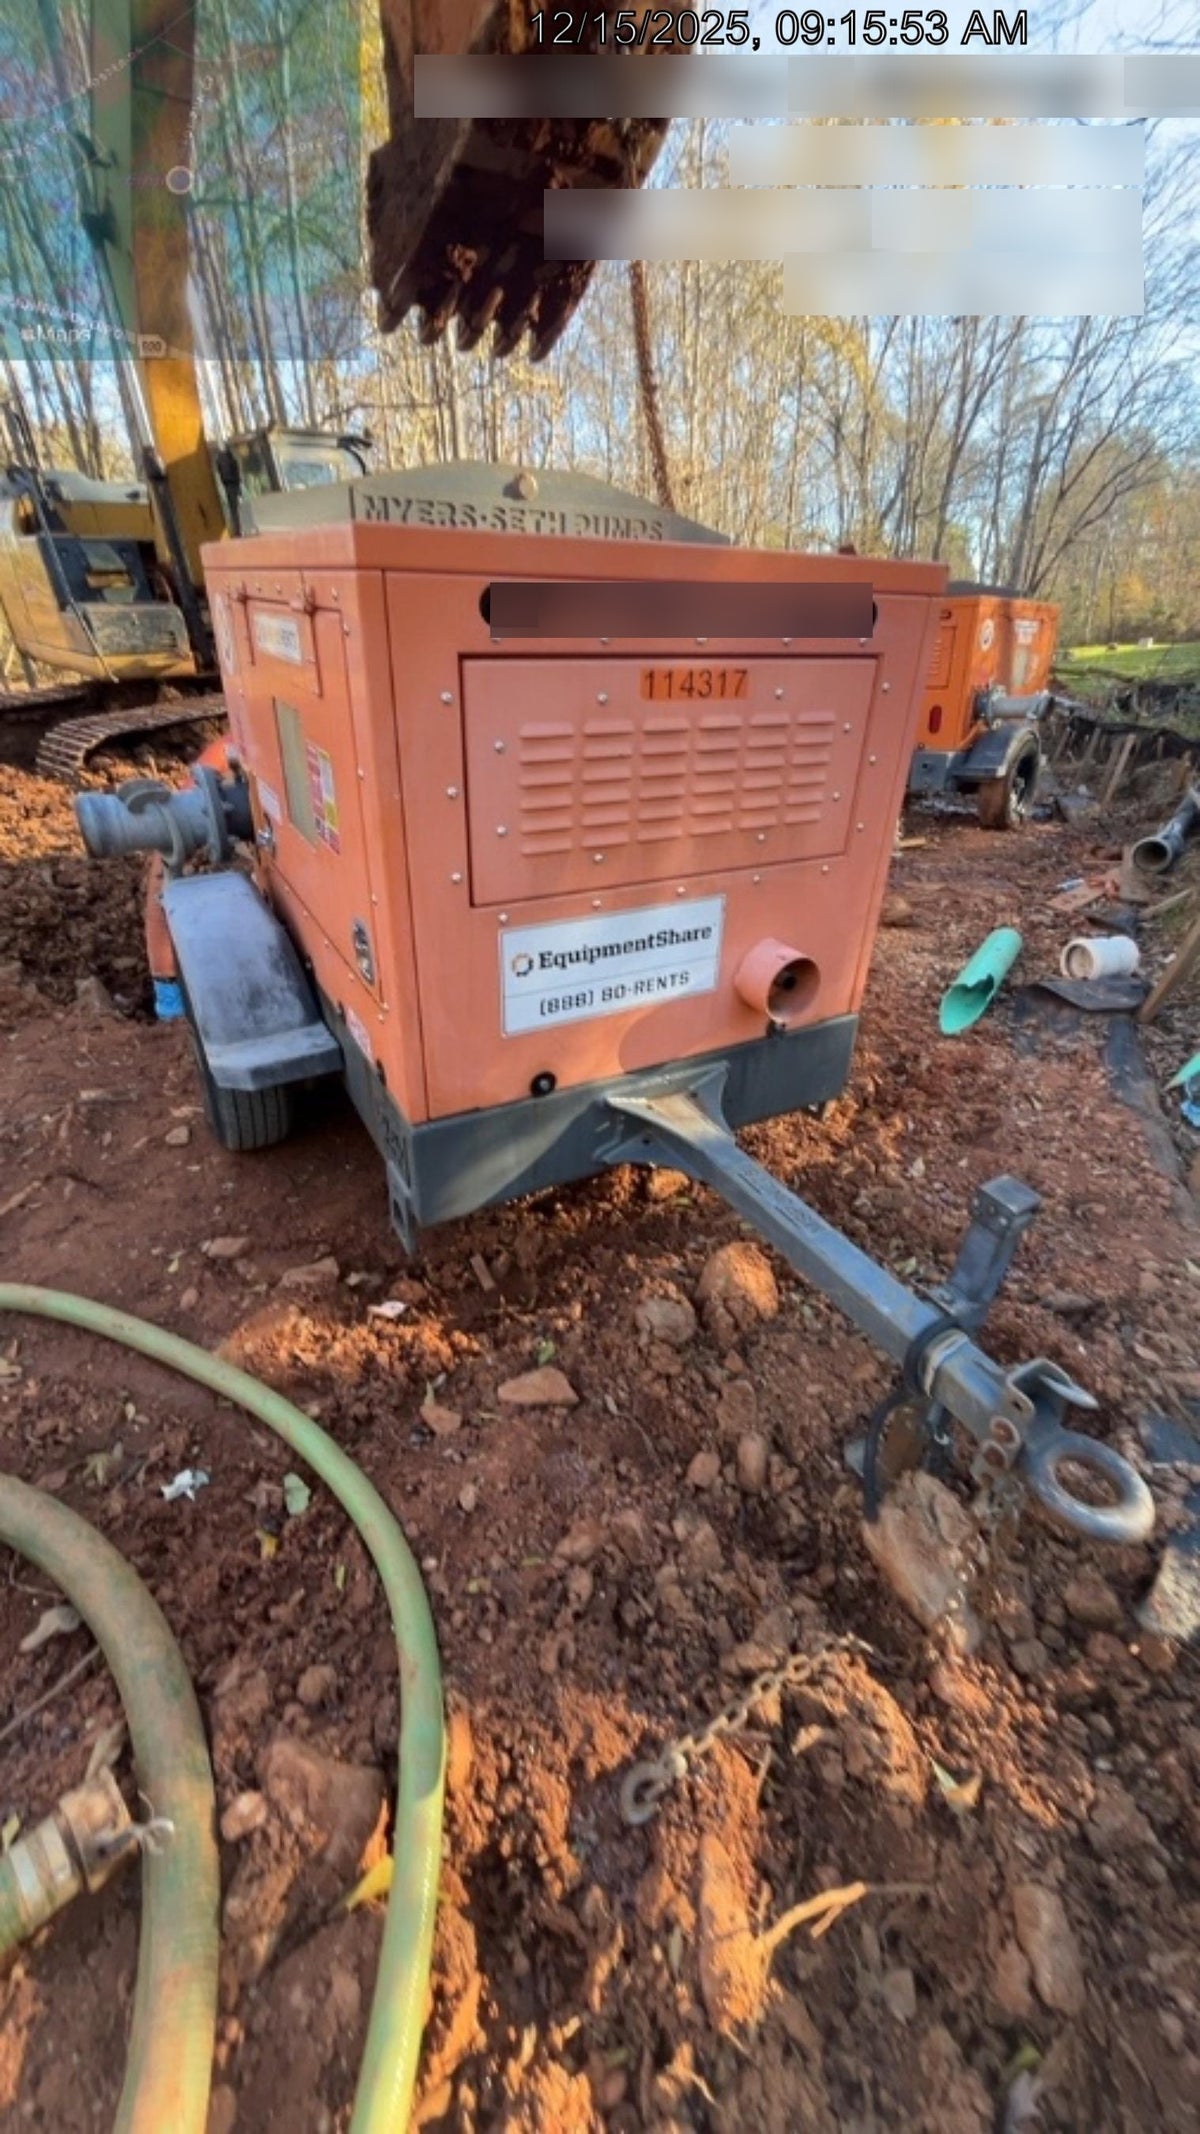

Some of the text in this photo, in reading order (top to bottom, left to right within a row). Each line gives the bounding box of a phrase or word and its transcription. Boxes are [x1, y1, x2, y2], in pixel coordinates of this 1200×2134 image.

[575, 512, 663, 541] PUMPS
[644, 668, 748, 699] 114317
[538, 926, 712, 970] EquipmentShare
[540, 990, 594, 1016] (888)
